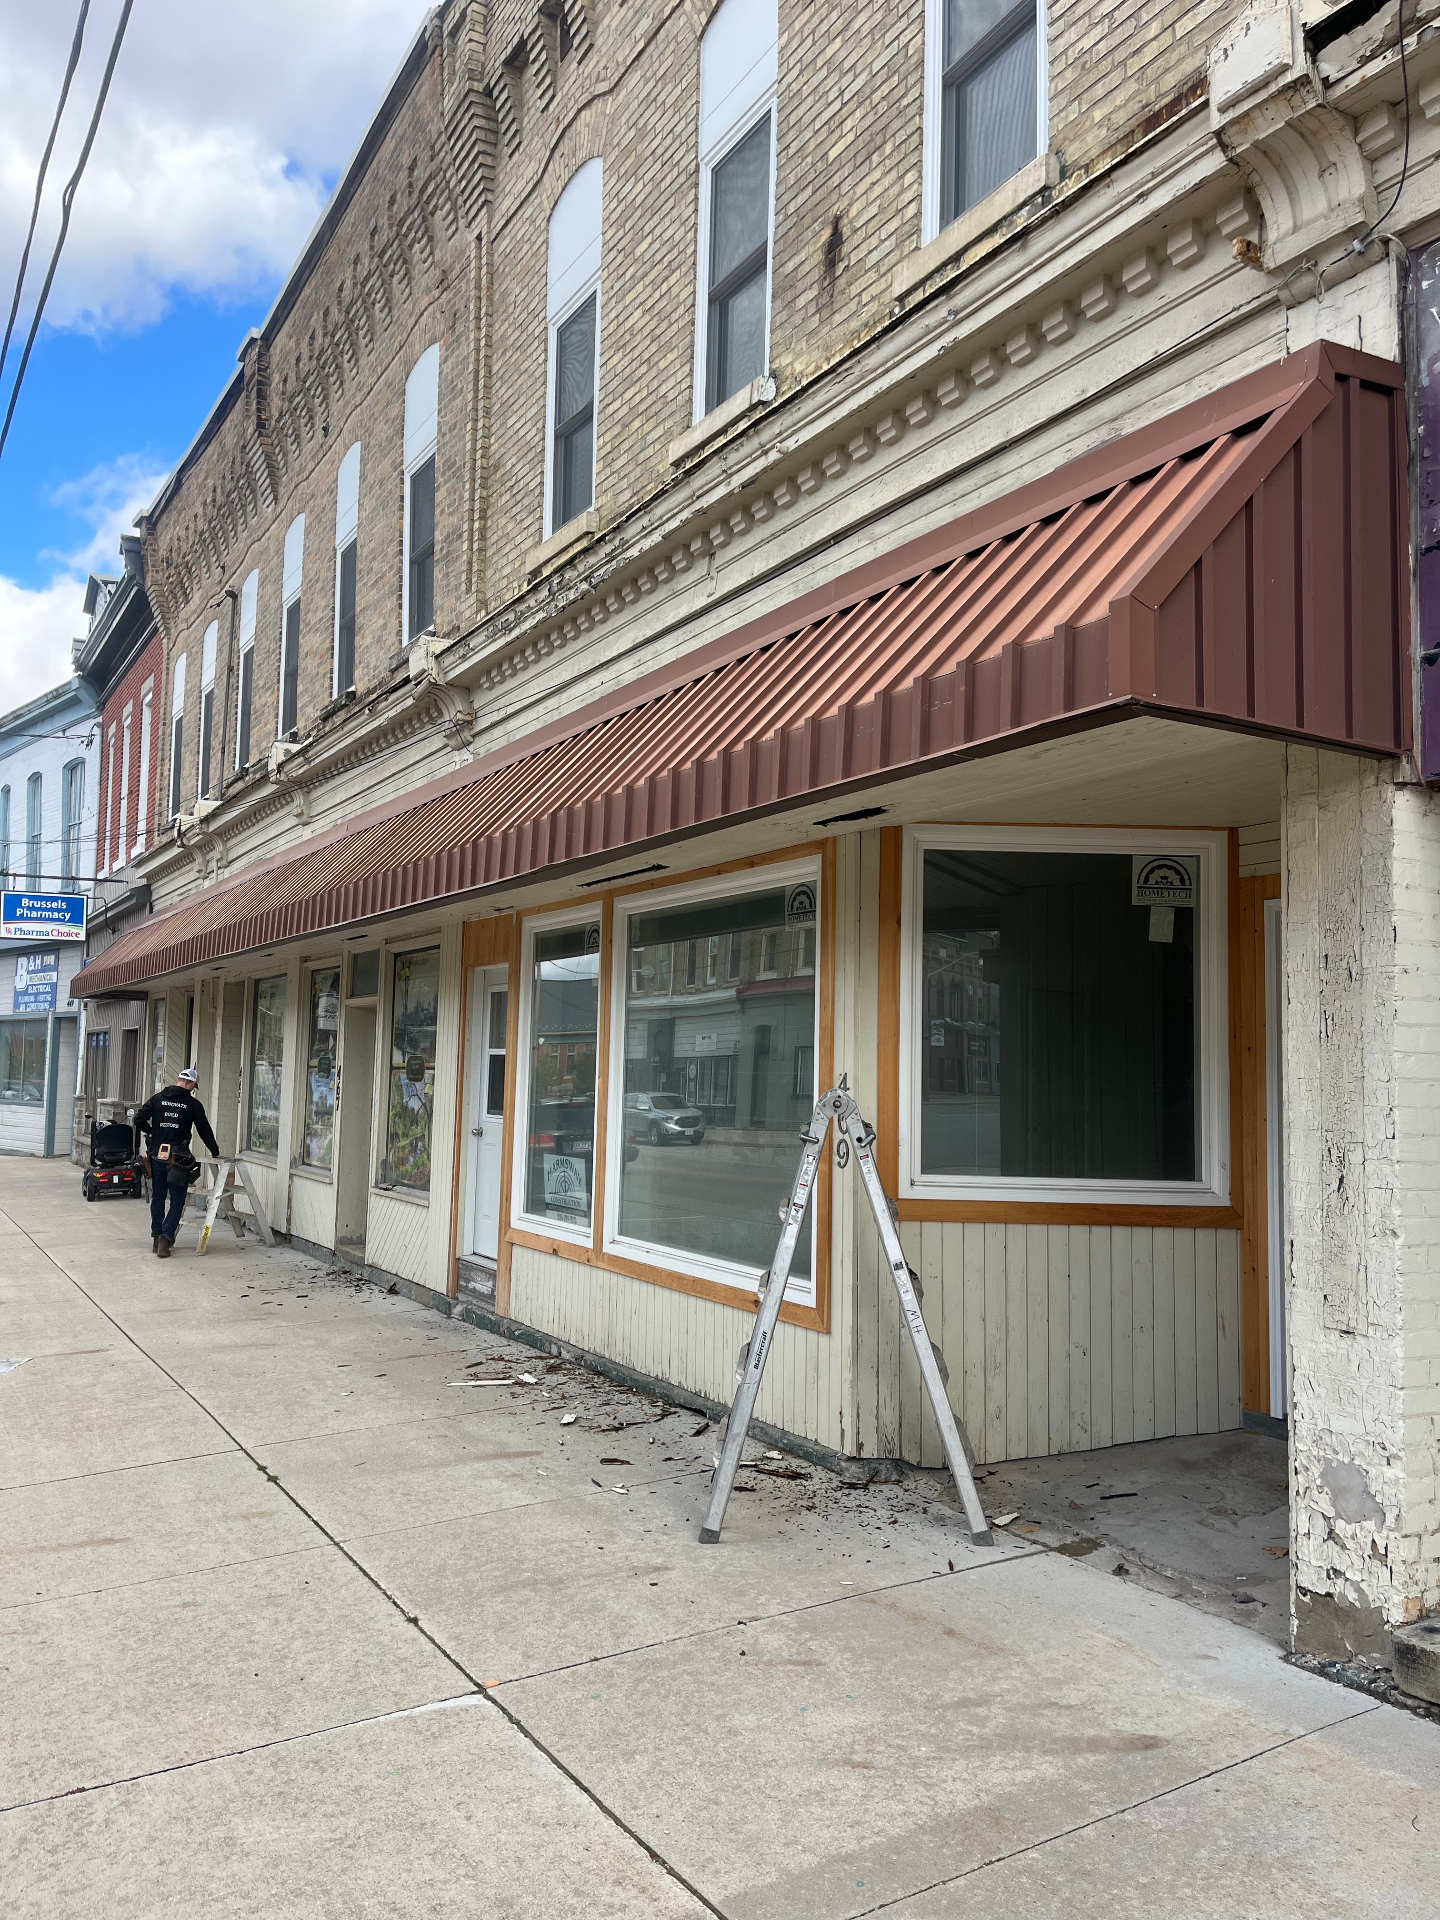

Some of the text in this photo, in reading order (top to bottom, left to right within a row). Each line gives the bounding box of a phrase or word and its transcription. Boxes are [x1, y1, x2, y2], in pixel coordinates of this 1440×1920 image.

[1137, 889, 1192, 899] HOMETECH
[21, 898, 67, 908] Brussels
[16, 908, 71, 921] Pharmacy
[29, 956, 35, 970] &
[35, 955, 42, 970] H
[28, 973, 54, 983] MECHANICAL
[27, 985, 52, 993] ELECTRICAL
[551, 1196, 582, 1208] CONSTRUCTION
